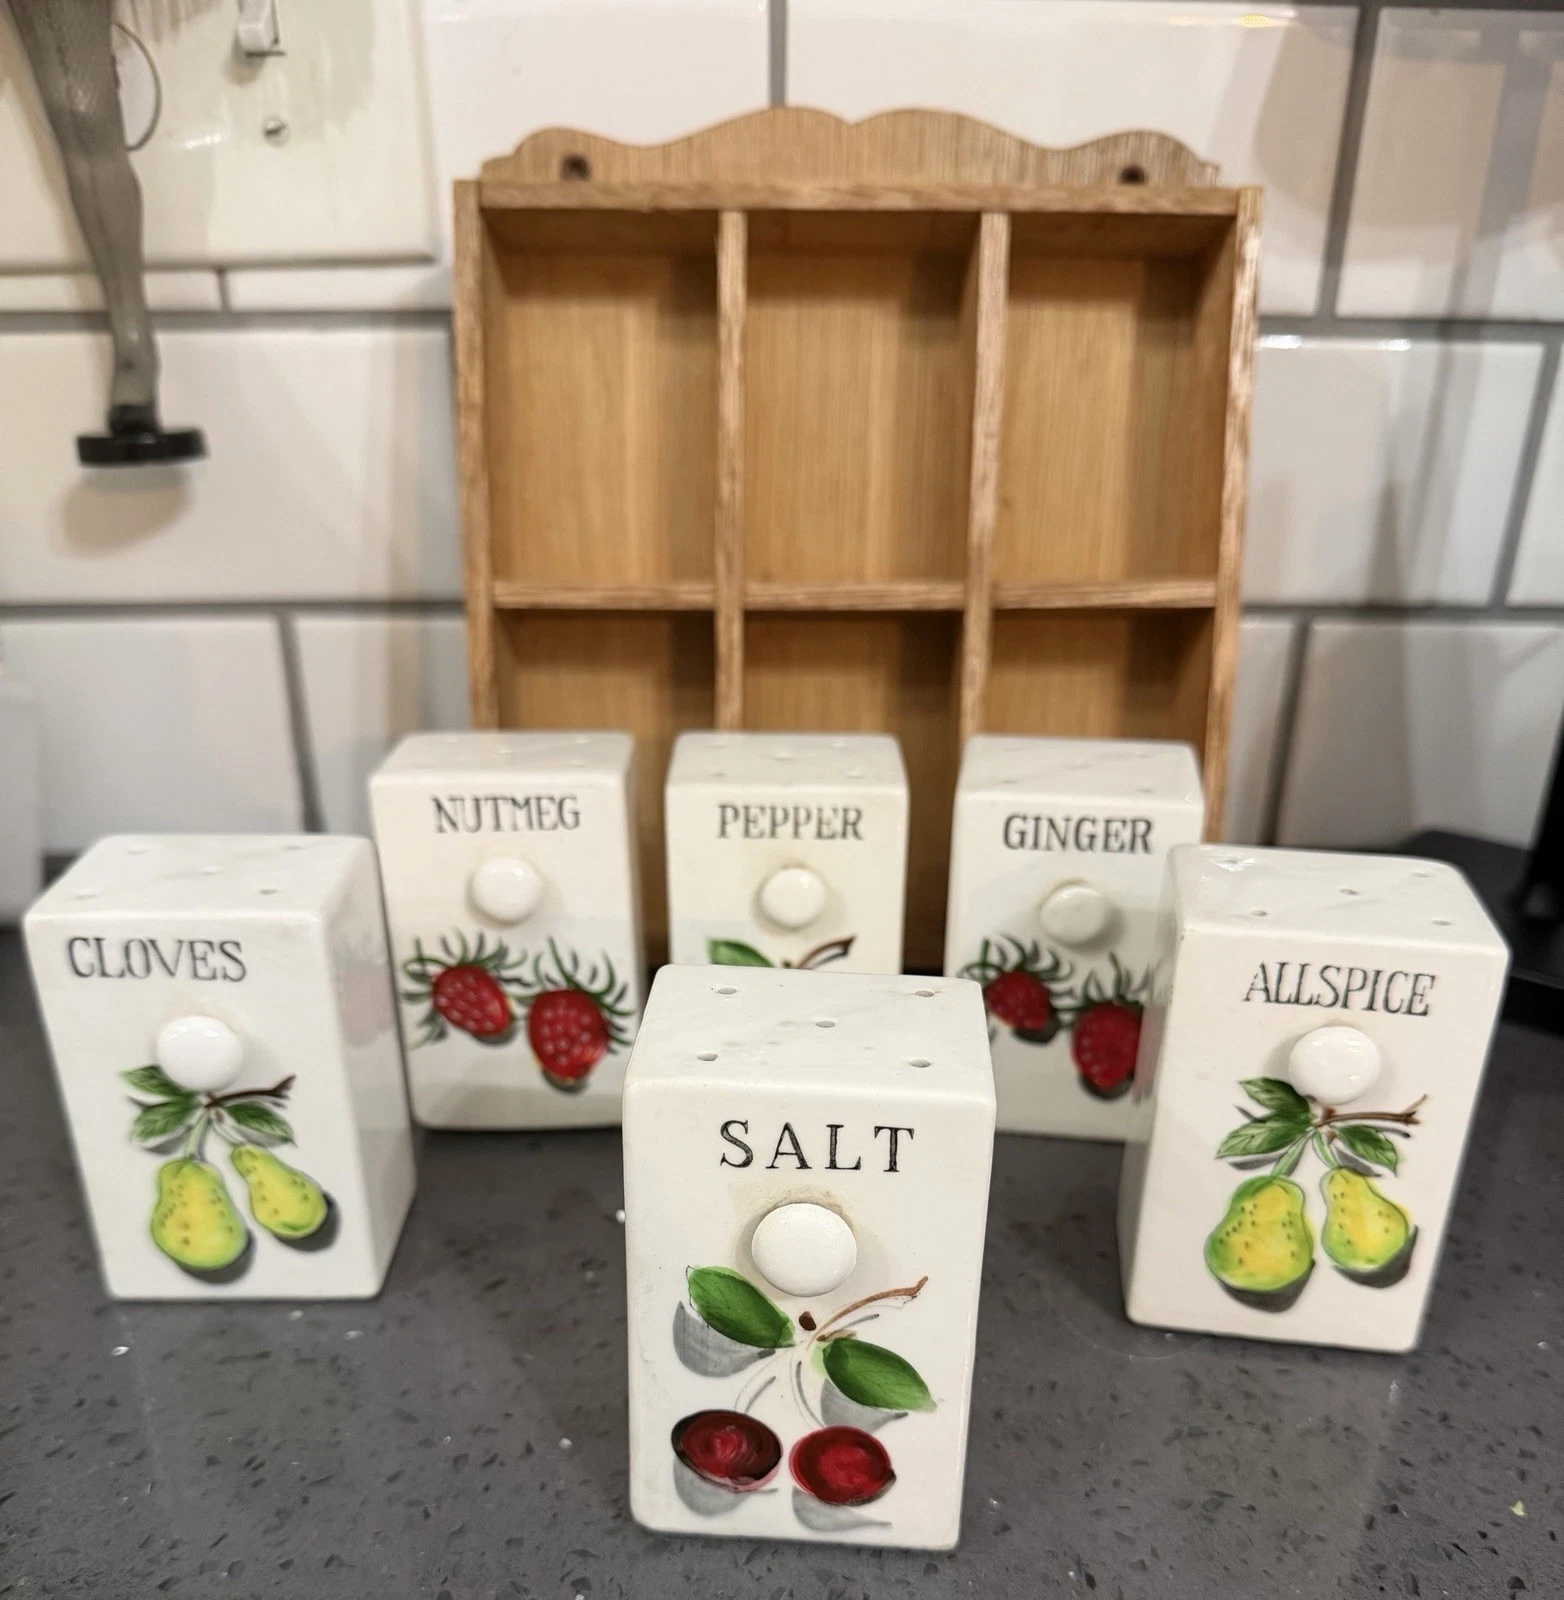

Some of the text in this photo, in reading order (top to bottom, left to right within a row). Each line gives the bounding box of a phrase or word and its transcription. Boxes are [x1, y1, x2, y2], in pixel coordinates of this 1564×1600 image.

[432, 795, 581, 834] NUTMEG
[717, 803, 864, 840] PEPPER
[1003, 814, 1153, 855] GINGER
[66, 936, 248, 983] CLOVES
[1243, 961, 1437, 1018] ALLSPICE
[719, 1119, 915, 1174] SALT
